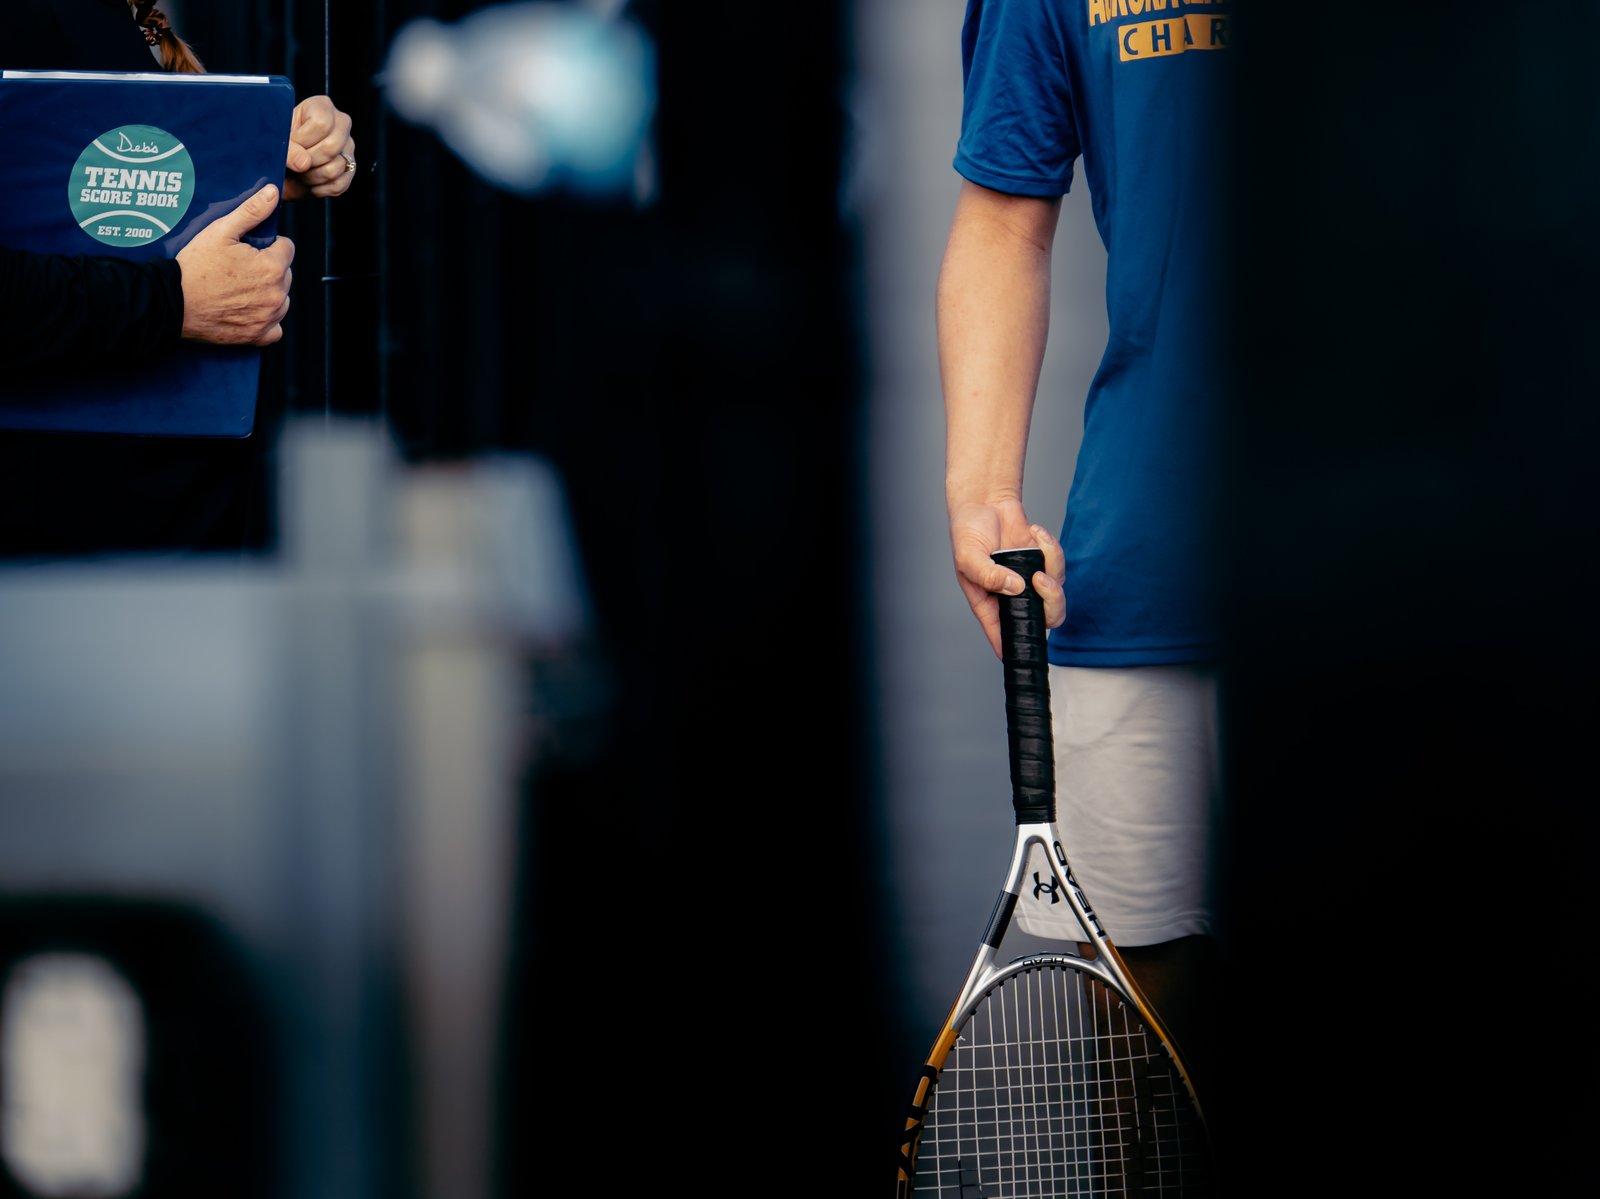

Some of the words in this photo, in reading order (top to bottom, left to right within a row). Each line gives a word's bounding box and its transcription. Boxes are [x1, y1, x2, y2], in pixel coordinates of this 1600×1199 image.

[116, 131, 159, 154] Deb's
[84, 166, 183, 193] TENNIS
[79, 188, 133, 206] SCORE
[135, 192, 180, 208] BOOK
[97, 225, 121, 237] EST.
[124, 227, 153, 239] 2000
[1053, 840, 1106, 938] HEAD
[1023, 957, 1065, 967] HEAD
